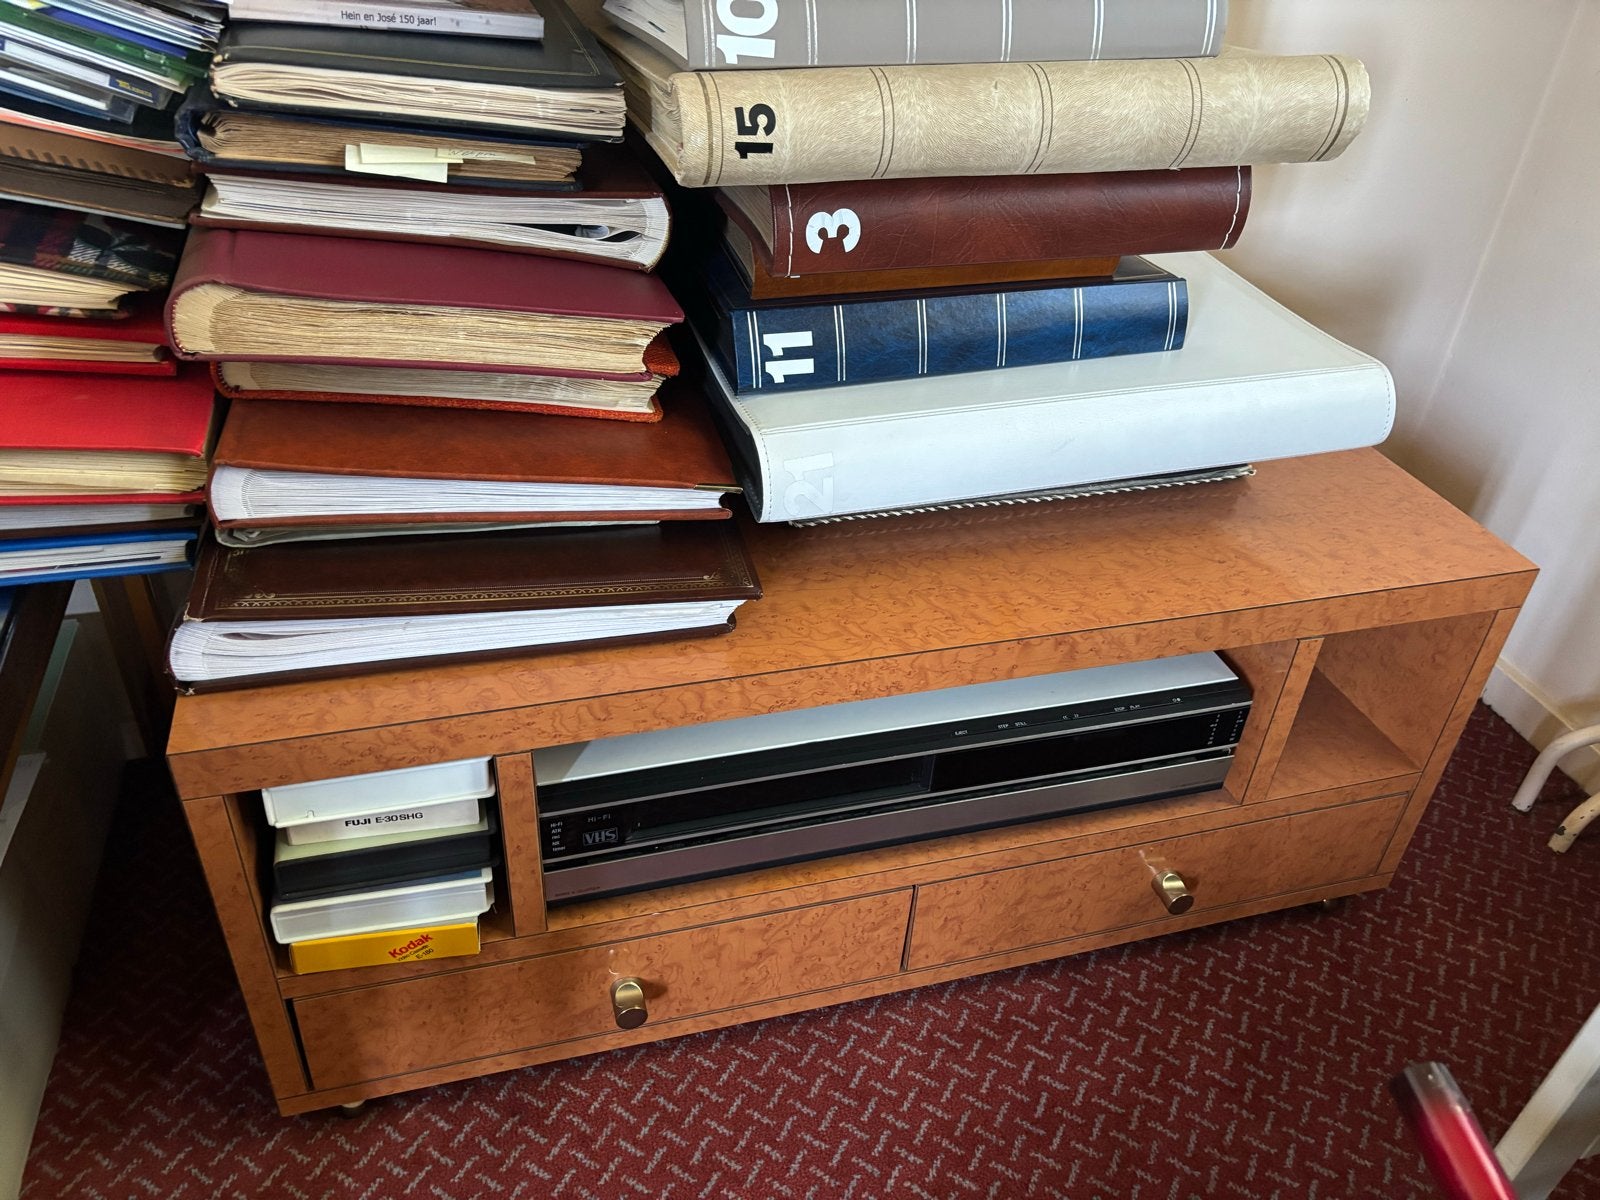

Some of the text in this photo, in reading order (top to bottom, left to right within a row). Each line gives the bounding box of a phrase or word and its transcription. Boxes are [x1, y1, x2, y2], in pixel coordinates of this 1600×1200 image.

[341, 10, 437, 27] Hein en José 150 jaar!
[716, 0, 779, 65] 10
[735, 103, 776, 159] 15
[805, 207, 861, 254] 3
[763, 330, 815, 384] 11
[783, 452, 834, 516] 21
[344, 817, 371, 827] FUJI
[584, 828, 617, 845] VHS
[388, 933, 433, 959] Kodak
